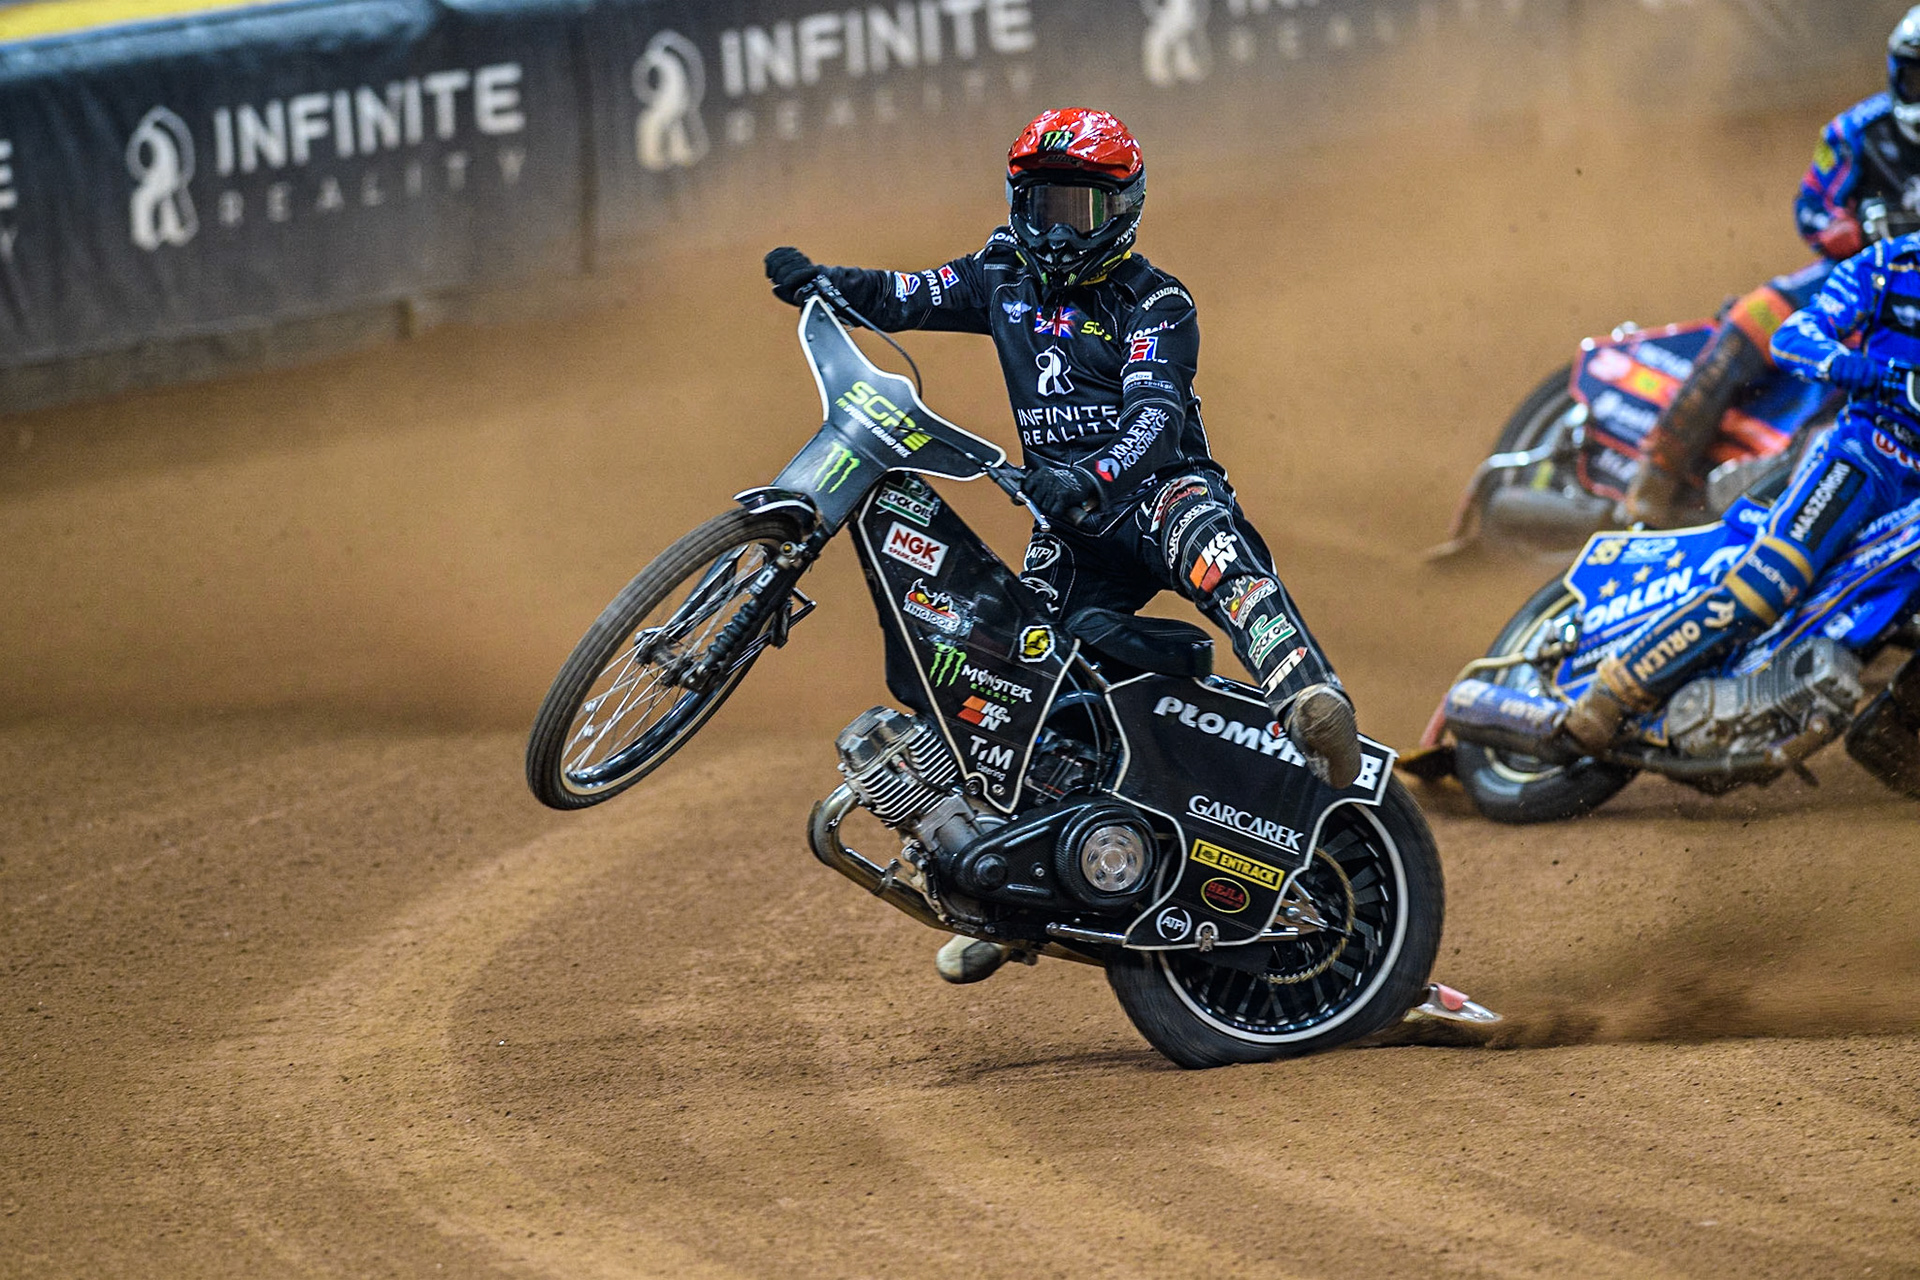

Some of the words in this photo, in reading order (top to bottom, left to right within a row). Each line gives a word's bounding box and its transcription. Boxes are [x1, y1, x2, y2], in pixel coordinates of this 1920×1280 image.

[719, 0, 1035, 98] INFINITE
[213, 62, 526, 177] INFINITE
[1017, 405, 1118, 426] INFINITE
[1022, 417, 1120, 446] REALITY
[871, 426, 898, 447] GRAND
[891, 442, 913, 459] PRIX
[912, 502, 932, 519] OIL
[888, 546, 911, 562] SPARK
[910, 557, 933, 571] PLUGS
[891, 528, 941, 563] NGK
[1582, 566, 1693, 634] ORLEN
[1633, 620, 1700, 682] ORLEN
[961, 664, 1033, 703] MONSTER
[970, 683, 1018, 704] ENERGY
[1189, 795, 1304, 850] GARCAREK
[1219, 854, 1277, 884] ENTRACK
[1162, 915, 1187, 932] ATPI
